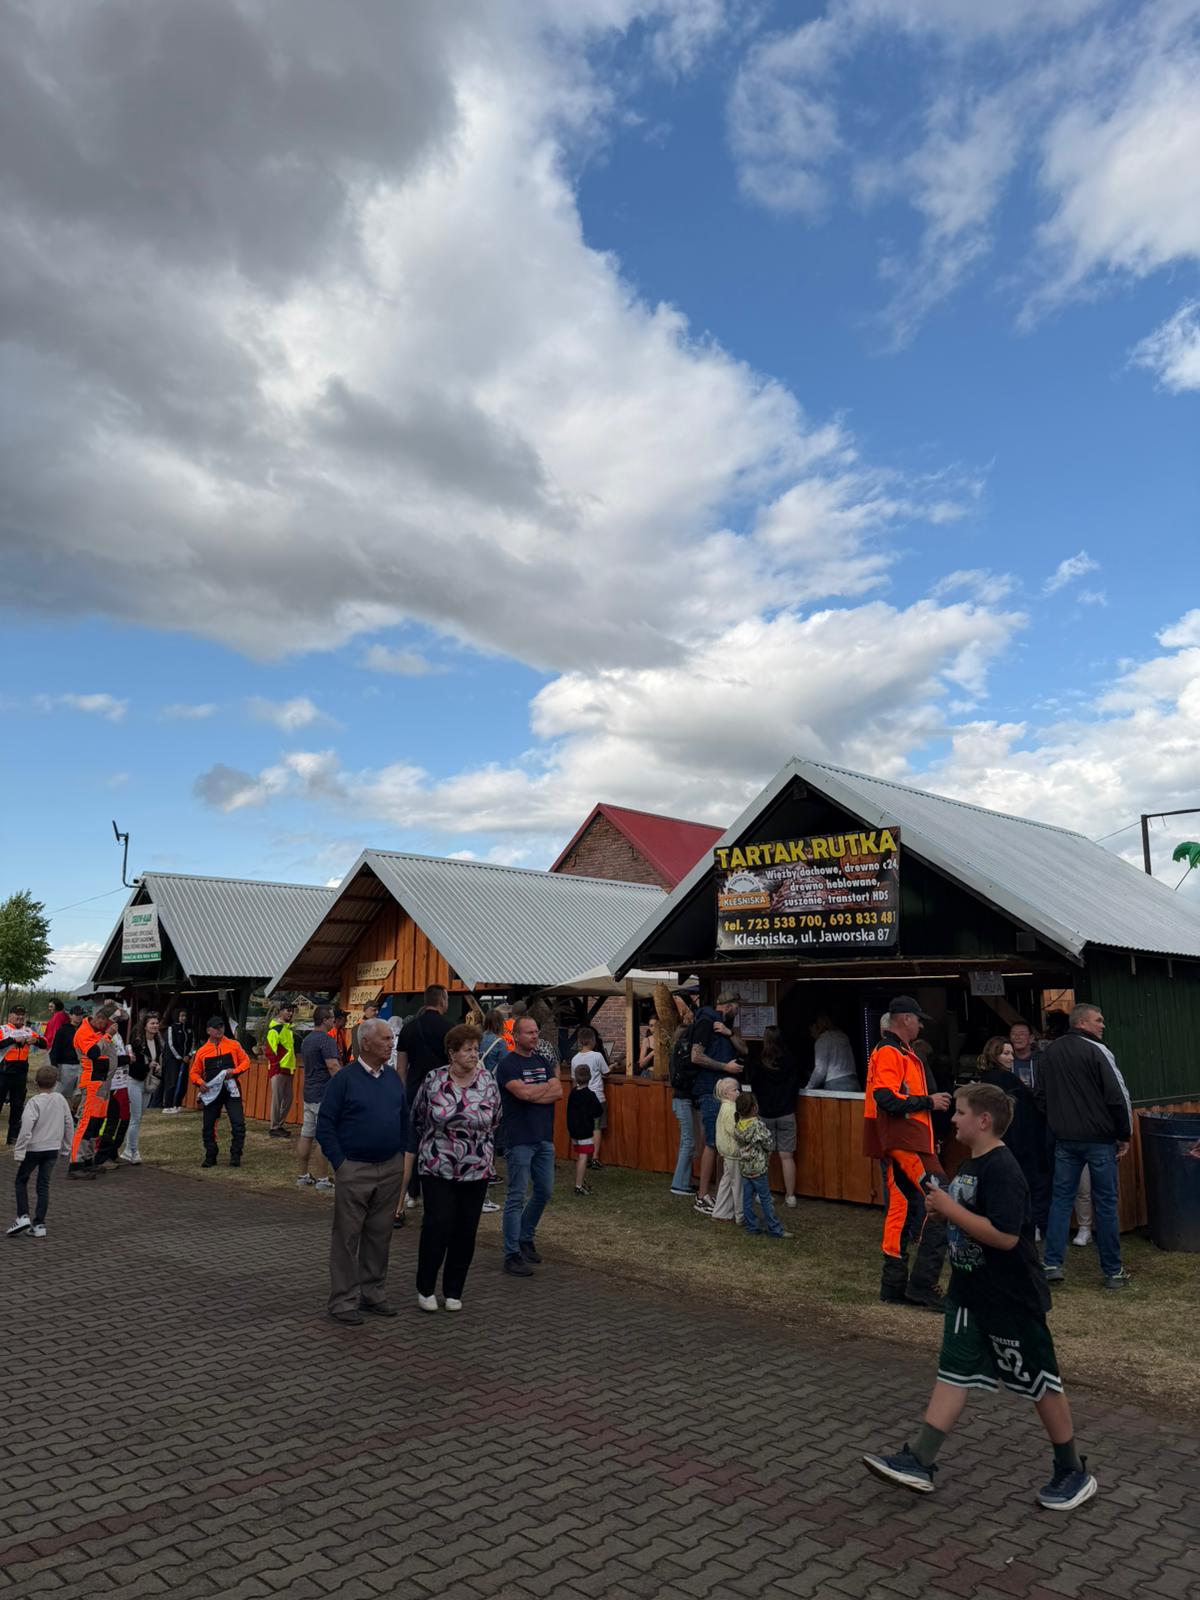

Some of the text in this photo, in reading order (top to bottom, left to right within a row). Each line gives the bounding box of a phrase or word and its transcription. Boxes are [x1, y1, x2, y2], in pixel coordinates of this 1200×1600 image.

[717, 830, 898, 869] TARTAK RUTKA
[799, 864, 843, 877] dachowe,
[844, 861, 880, 873] drewno
[790, 877, 881, 893] drewno heblowane,
[784, 895, 827, 908] suszenie,
[872, 890, 889, 902] HDS
[724, 919, 744, 931] tel.
[747, 918, 770, 930] 723
[773, 916, 796, 929] 538
[799, 915, 826, 929] 700,
[829, 913, 853, 925] 693
[855, 912, 878, 924] 833
[733, 928, 891, 946] Kleśniska, ul. Jaworska 87
